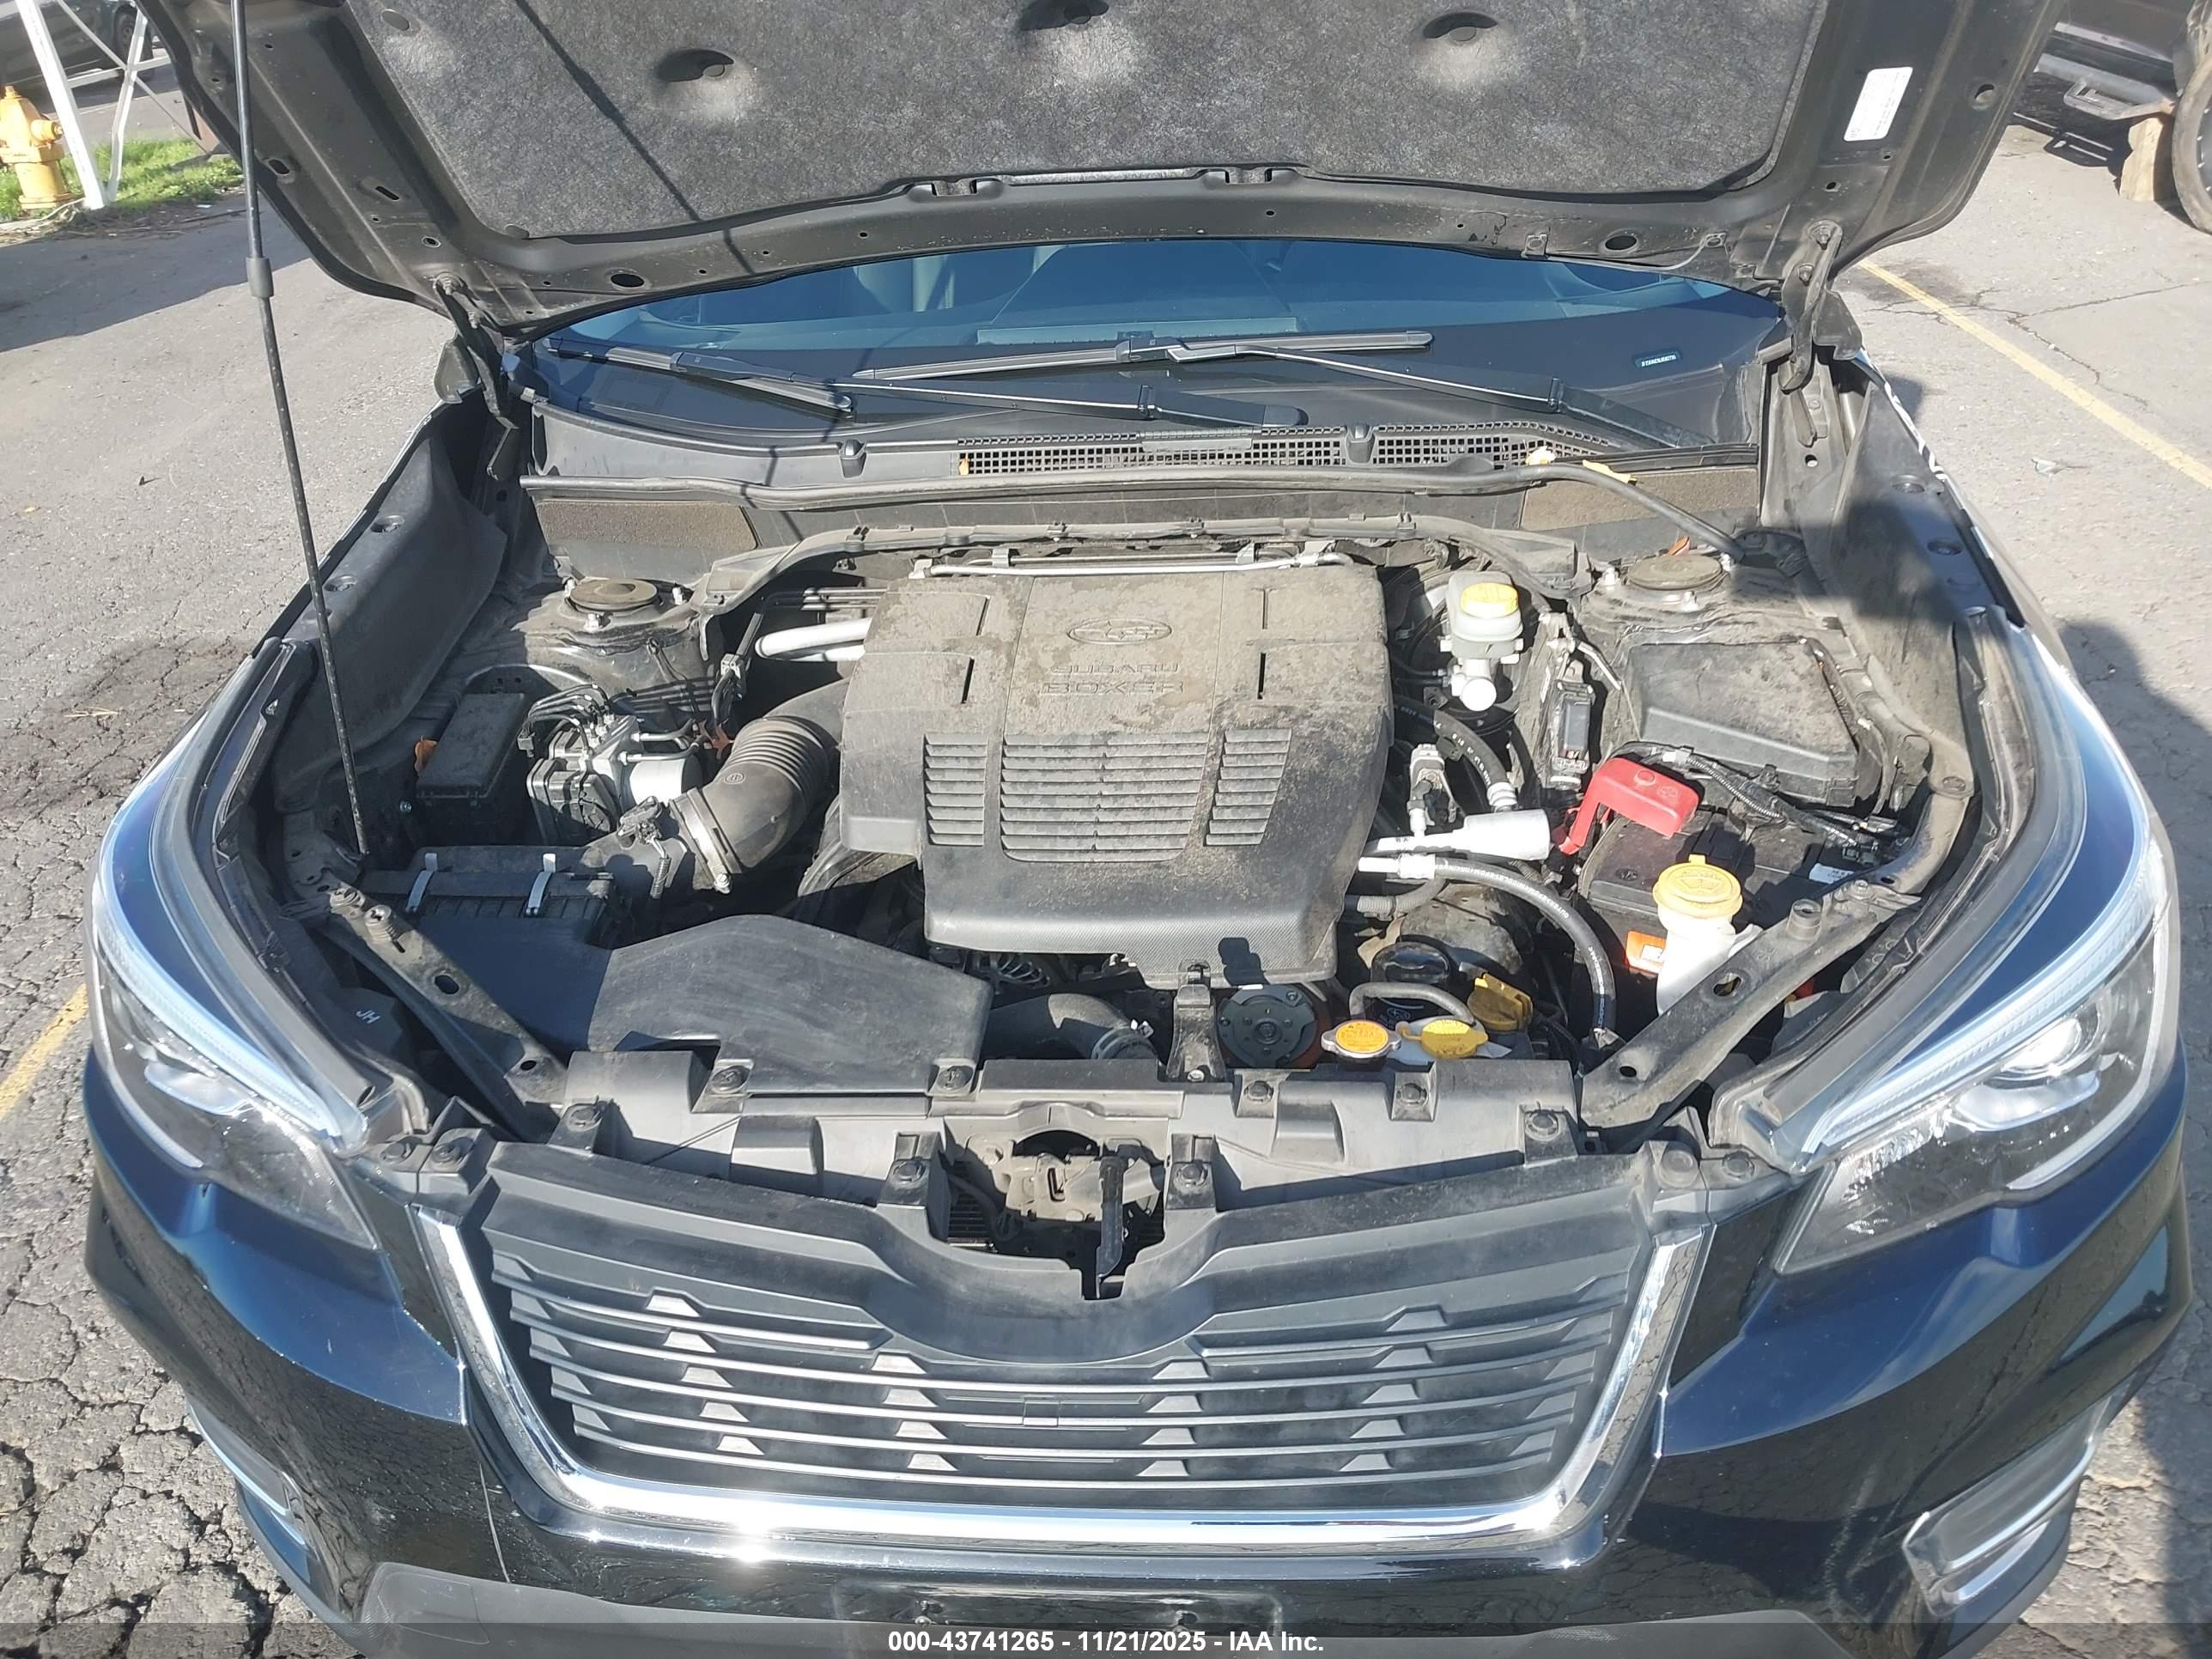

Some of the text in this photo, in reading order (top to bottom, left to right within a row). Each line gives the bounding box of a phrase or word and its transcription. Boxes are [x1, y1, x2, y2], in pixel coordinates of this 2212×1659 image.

[1050, 663, 1180, 674] SUBARU
[1039, 681, 1184, 694] BOXER
[356, 1009, 381, 1024] JH
